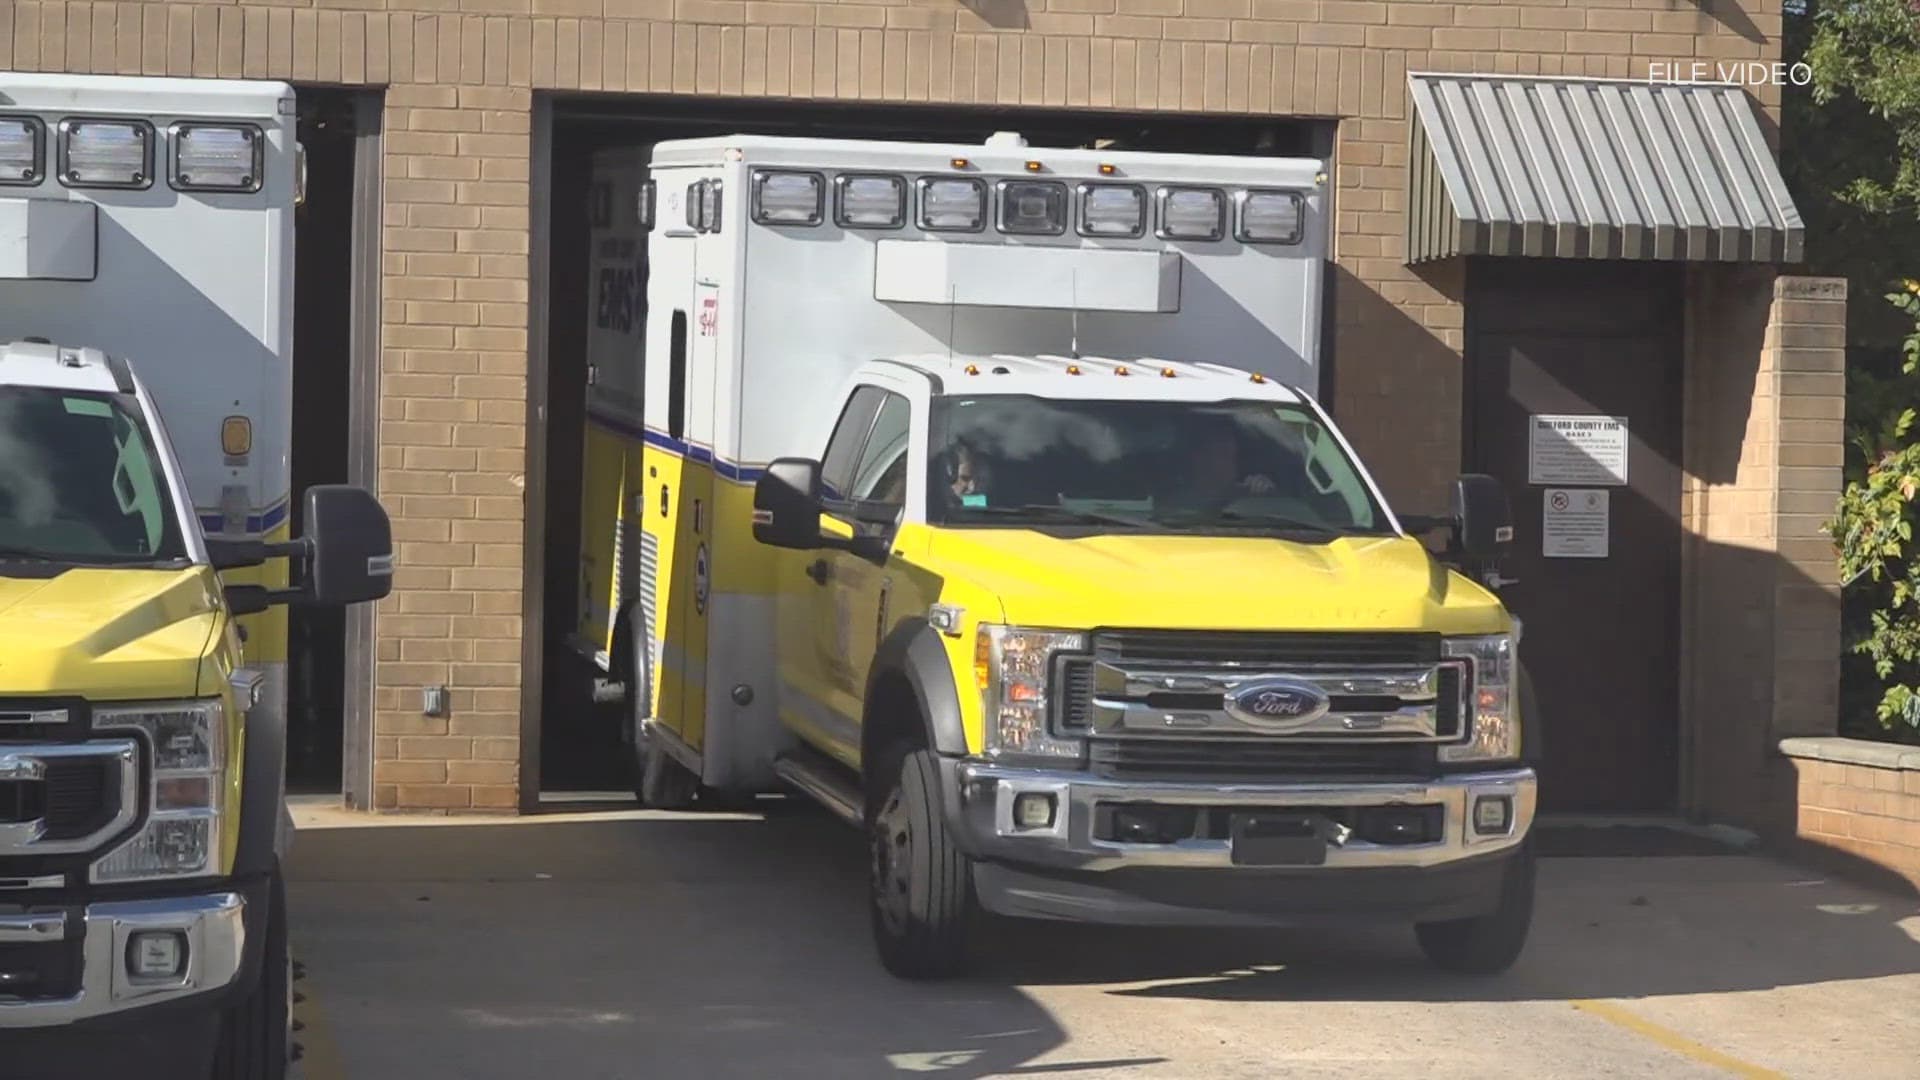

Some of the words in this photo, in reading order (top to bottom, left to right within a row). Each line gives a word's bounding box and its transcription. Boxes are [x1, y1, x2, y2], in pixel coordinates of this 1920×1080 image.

[1537, 421, 1572, 431] FORD
[1573, 422, 1603, 431] COUNTY
[1604, 422, 1620, 431] EMS
[1253, 691, 1301, 714] Ford
